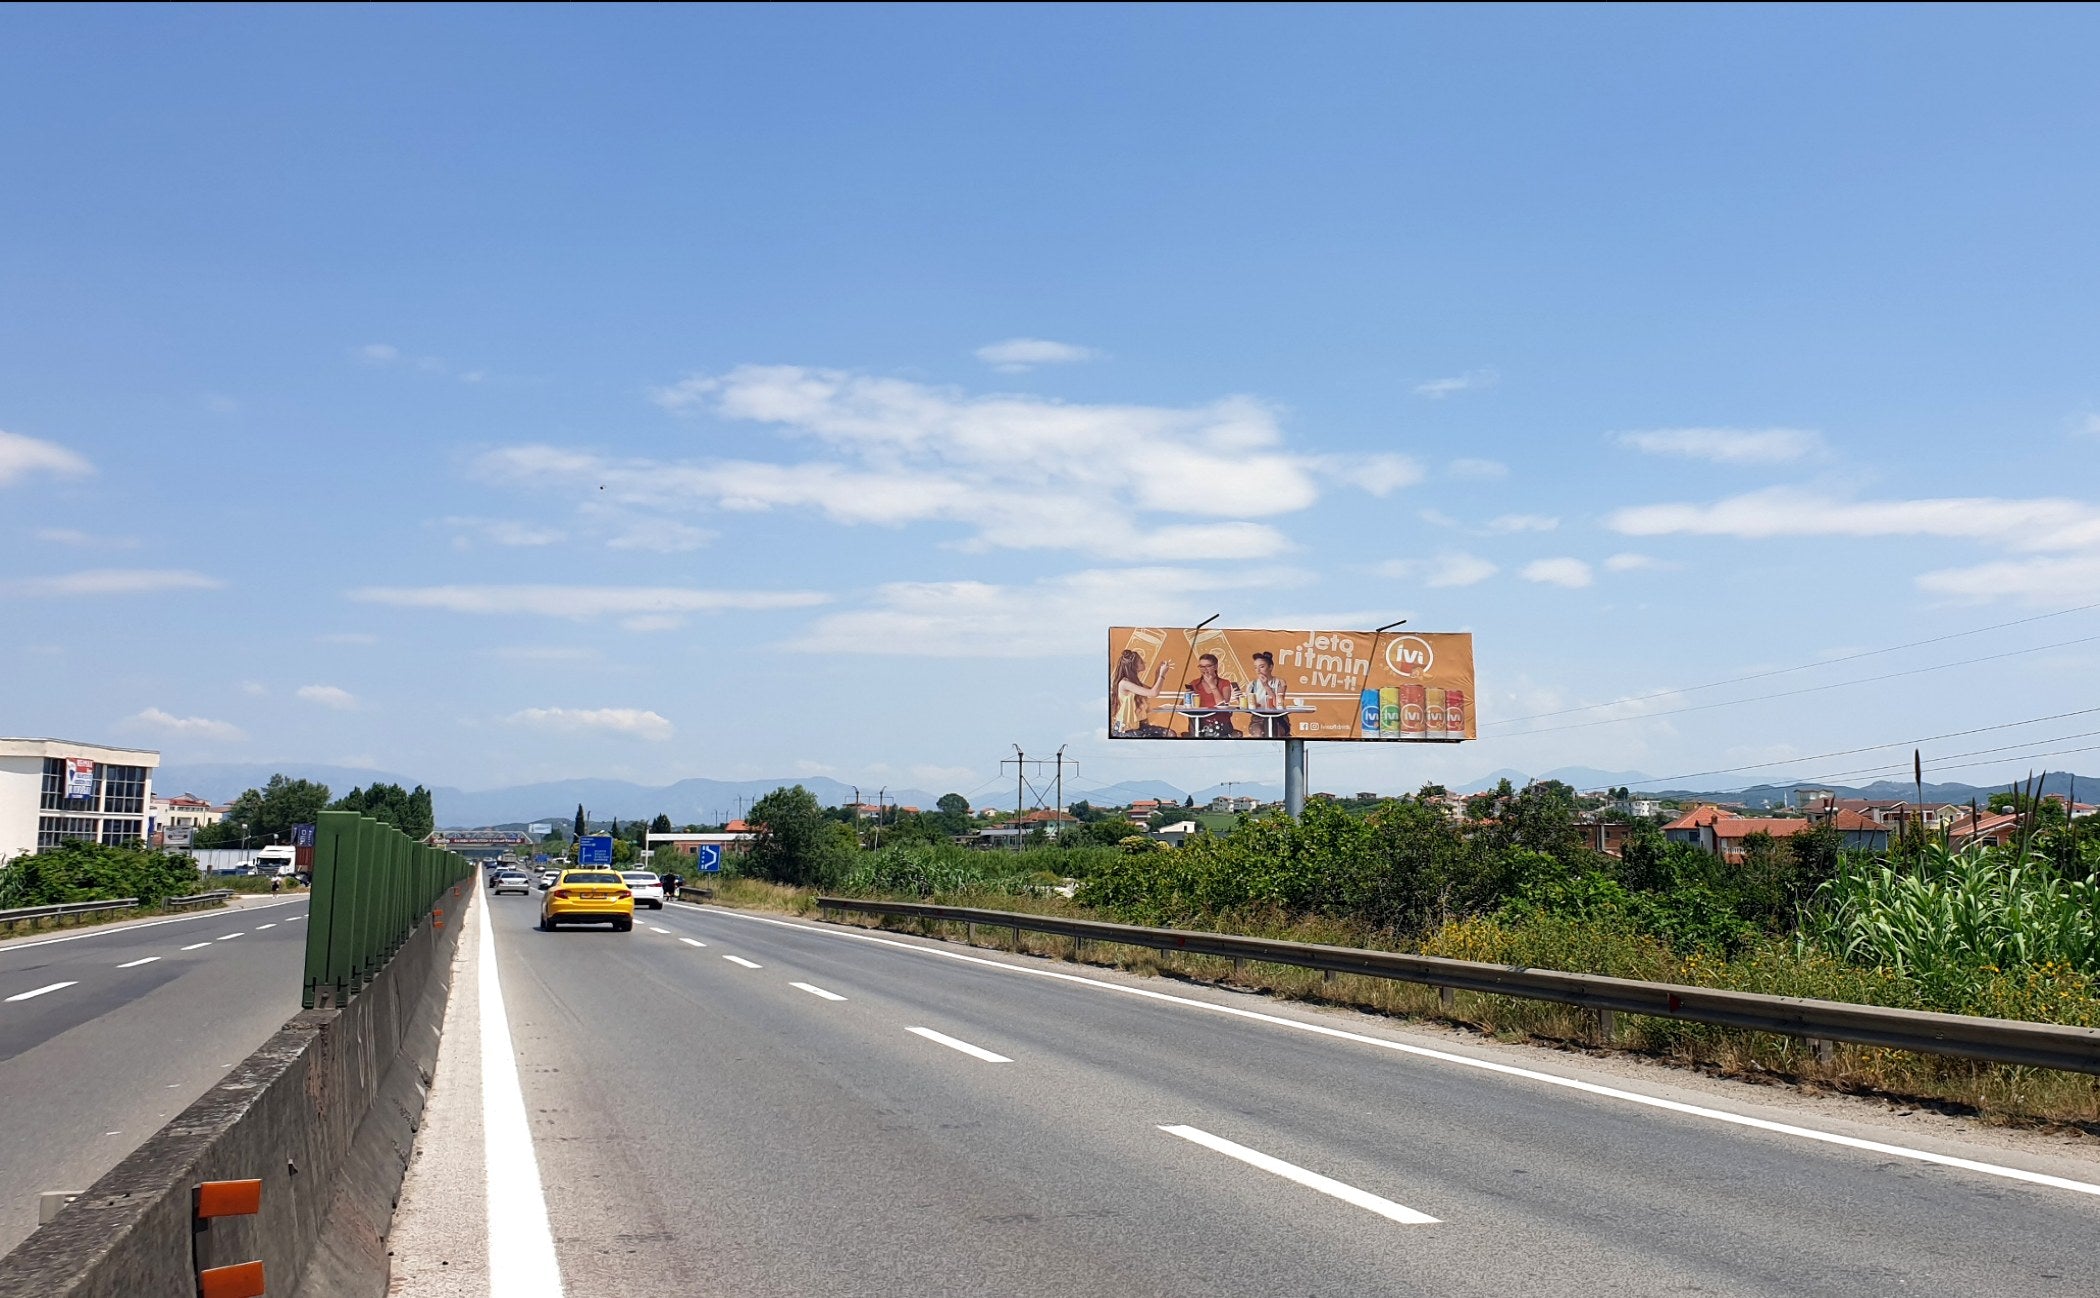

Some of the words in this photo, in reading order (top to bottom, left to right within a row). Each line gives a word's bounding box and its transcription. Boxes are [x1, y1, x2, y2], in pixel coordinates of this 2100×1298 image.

[1303, 631, 1354, 653] Jeto
[1279, 645, 1370, 676] ritmin
[1299, 675, 1309, 684] e
